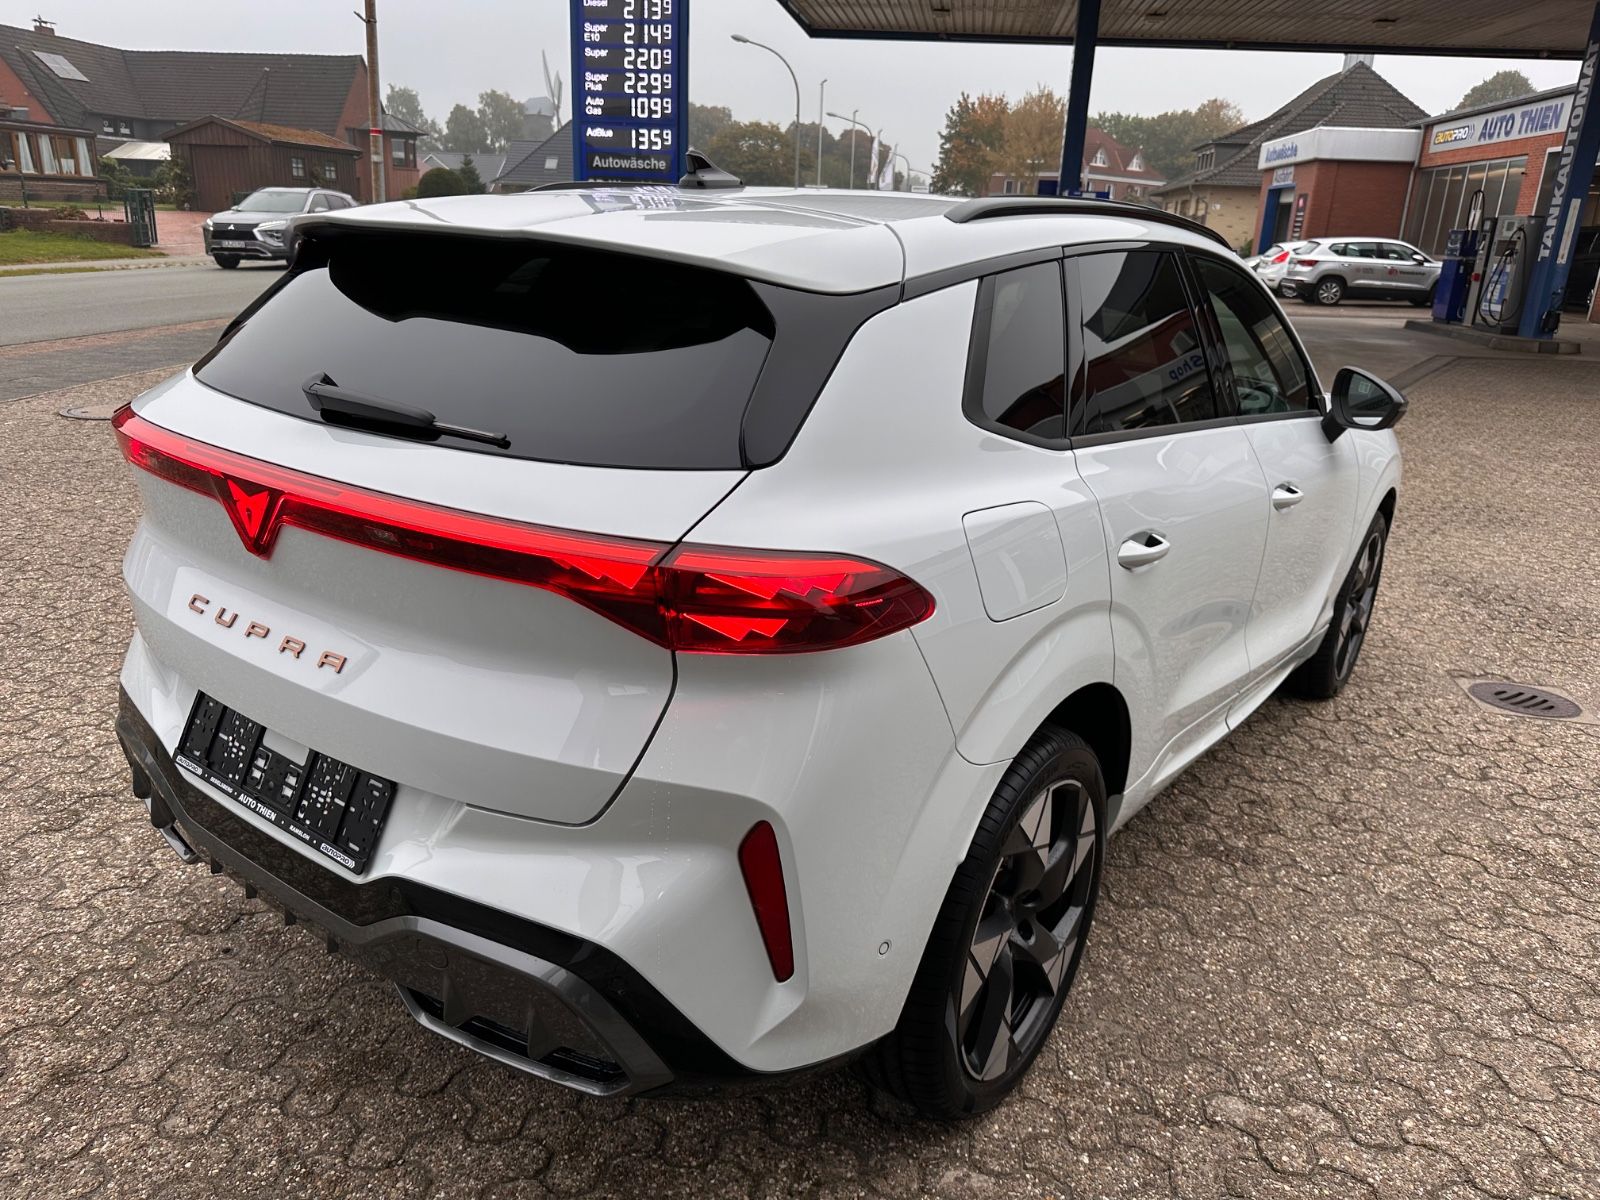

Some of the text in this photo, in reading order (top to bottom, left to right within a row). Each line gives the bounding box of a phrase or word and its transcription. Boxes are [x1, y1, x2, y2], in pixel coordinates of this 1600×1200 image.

[584, 22, 608, 33] Super
[584, 32, 600, 42] E10
[584, 47, 609, 59] Super
[585, 72, 609, 83] Super
[585, 82, 602, 92] Plus
[586, 96, 604, 106] Auto
[586, 106, 602, 116] Gas
[1478, 102, 1565, 142] AUTO THIEN
[586, 127, 614, 138] AdBlue
[1538, 40, 1600, 262] TANKAUTOMAT
[592, 155, 667, 171] Autowäsche
[188, 593, 348, 674] CUPRA
[238, 793, 257, 809] AUTO
[256, 803, 277, 821] THIEN
